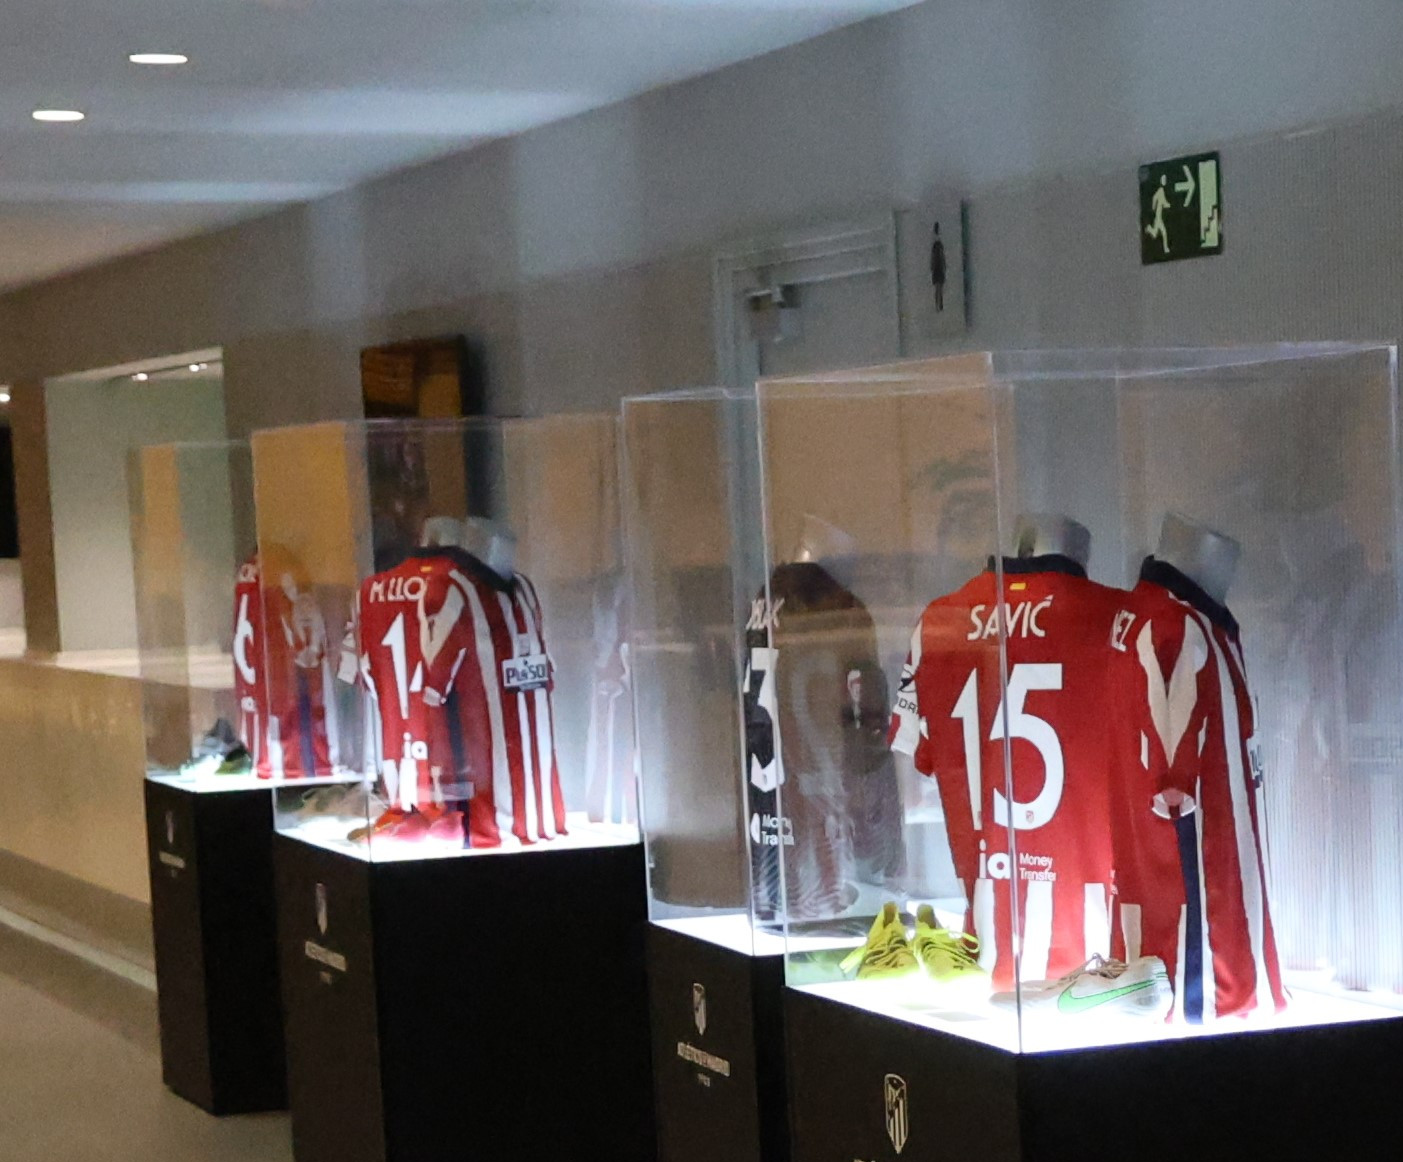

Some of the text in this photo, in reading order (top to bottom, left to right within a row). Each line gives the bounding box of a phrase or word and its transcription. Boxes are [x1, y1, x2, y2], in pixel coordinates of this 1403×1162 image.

[967, 594, 1054, 641] SAVIĆ
[950, 662, 1065, 830] 15
[979, 838, 1011, 880] ia
[1019, 852, 1054, 869] Money
